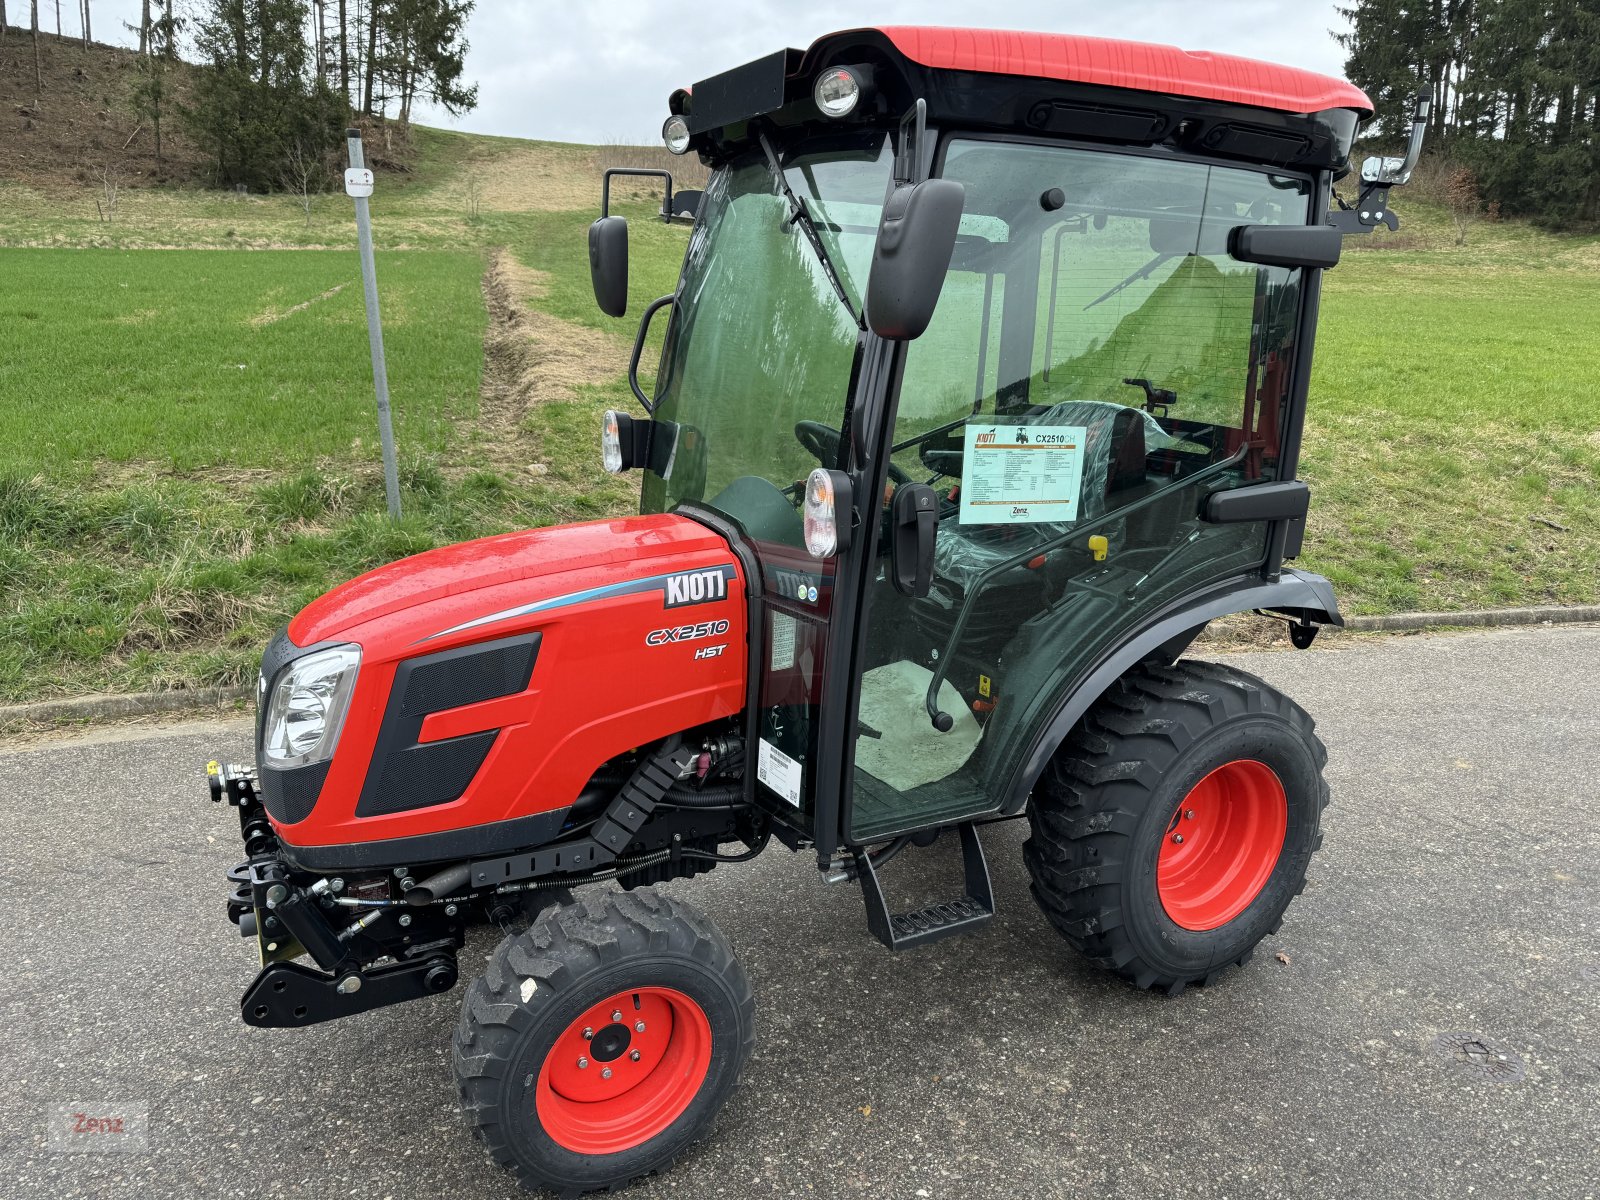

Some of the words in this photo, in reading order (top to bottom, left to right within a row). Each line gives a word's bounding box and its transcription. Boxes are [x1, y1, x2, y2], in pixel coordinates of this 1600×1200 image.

[976, 433, 996, 443] KIOTI
[667, 570, 724, 605] KIOTI
[646, 619, 729, 646] CX2510
[694, 643, 728, 660] HST
